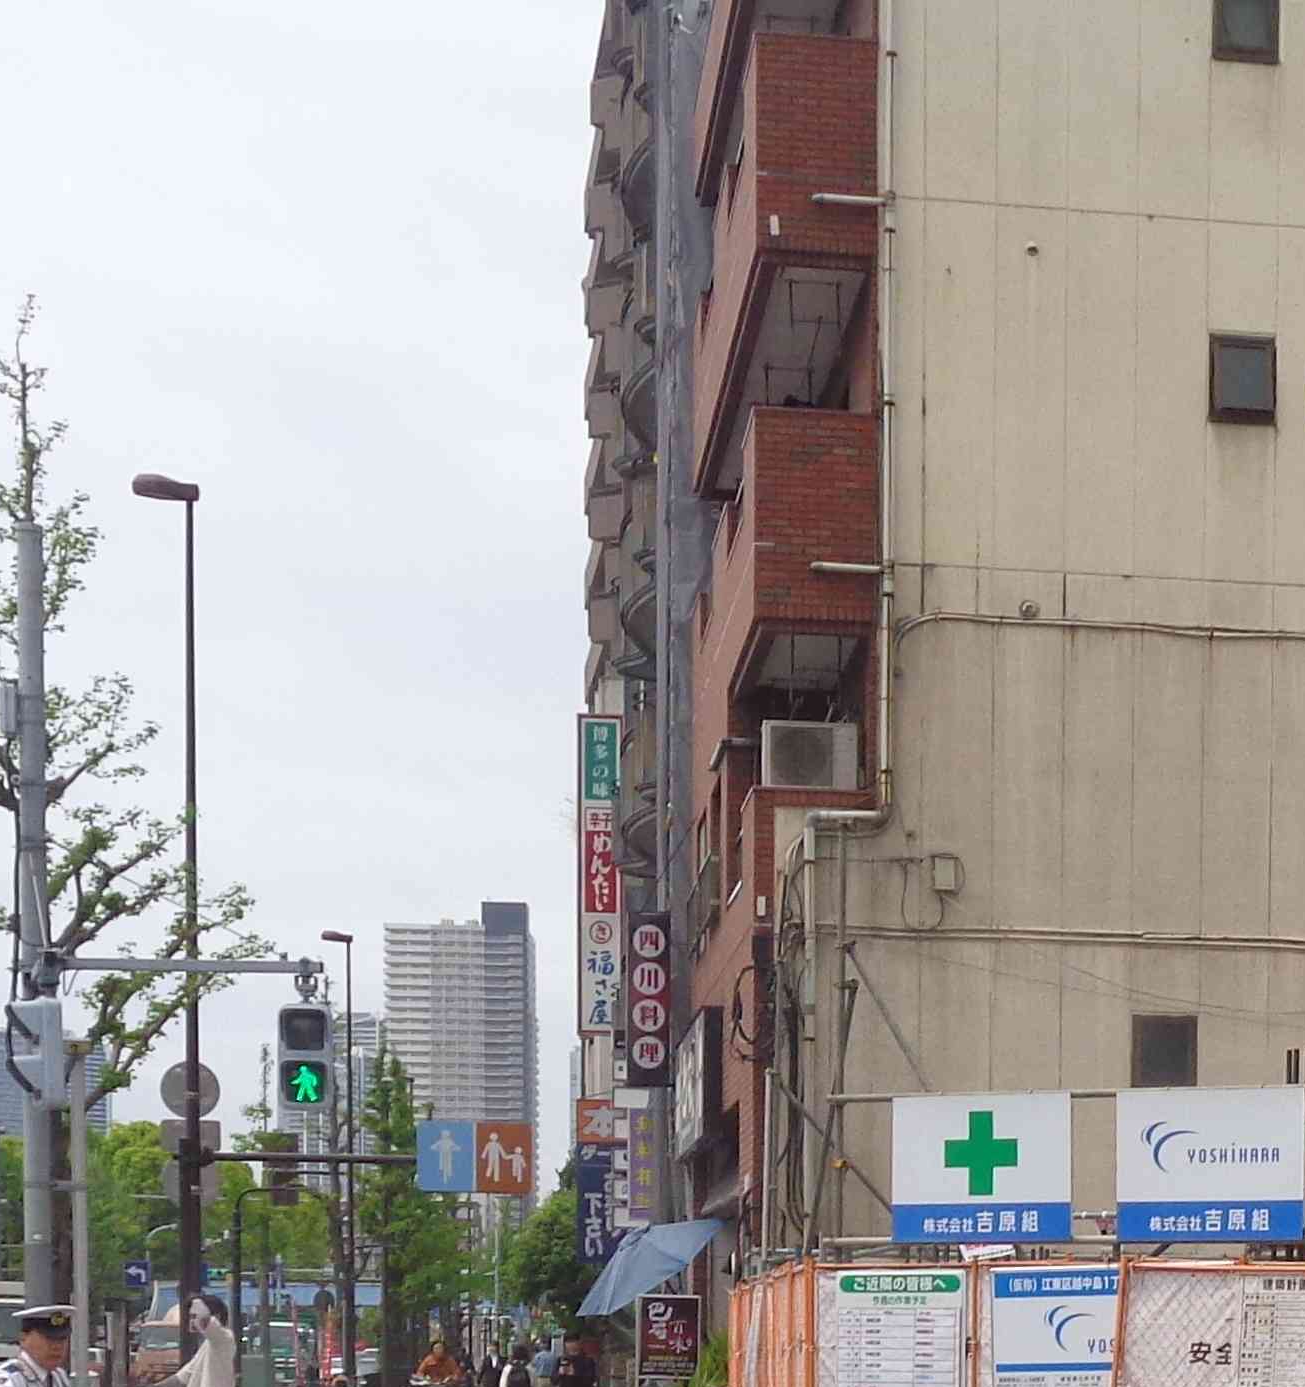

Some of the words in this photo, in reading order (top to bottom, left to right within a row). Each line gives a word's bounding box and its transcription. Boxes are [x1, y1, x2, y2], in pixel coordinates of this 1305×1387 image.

[592, 725, 610, 799] 博多の味
[590, 832, 612, 911] めんたい
[637, 929, 660, 1063] 四川料理
[852, 1276, 947, 1292] ご近隣の皆様へ
